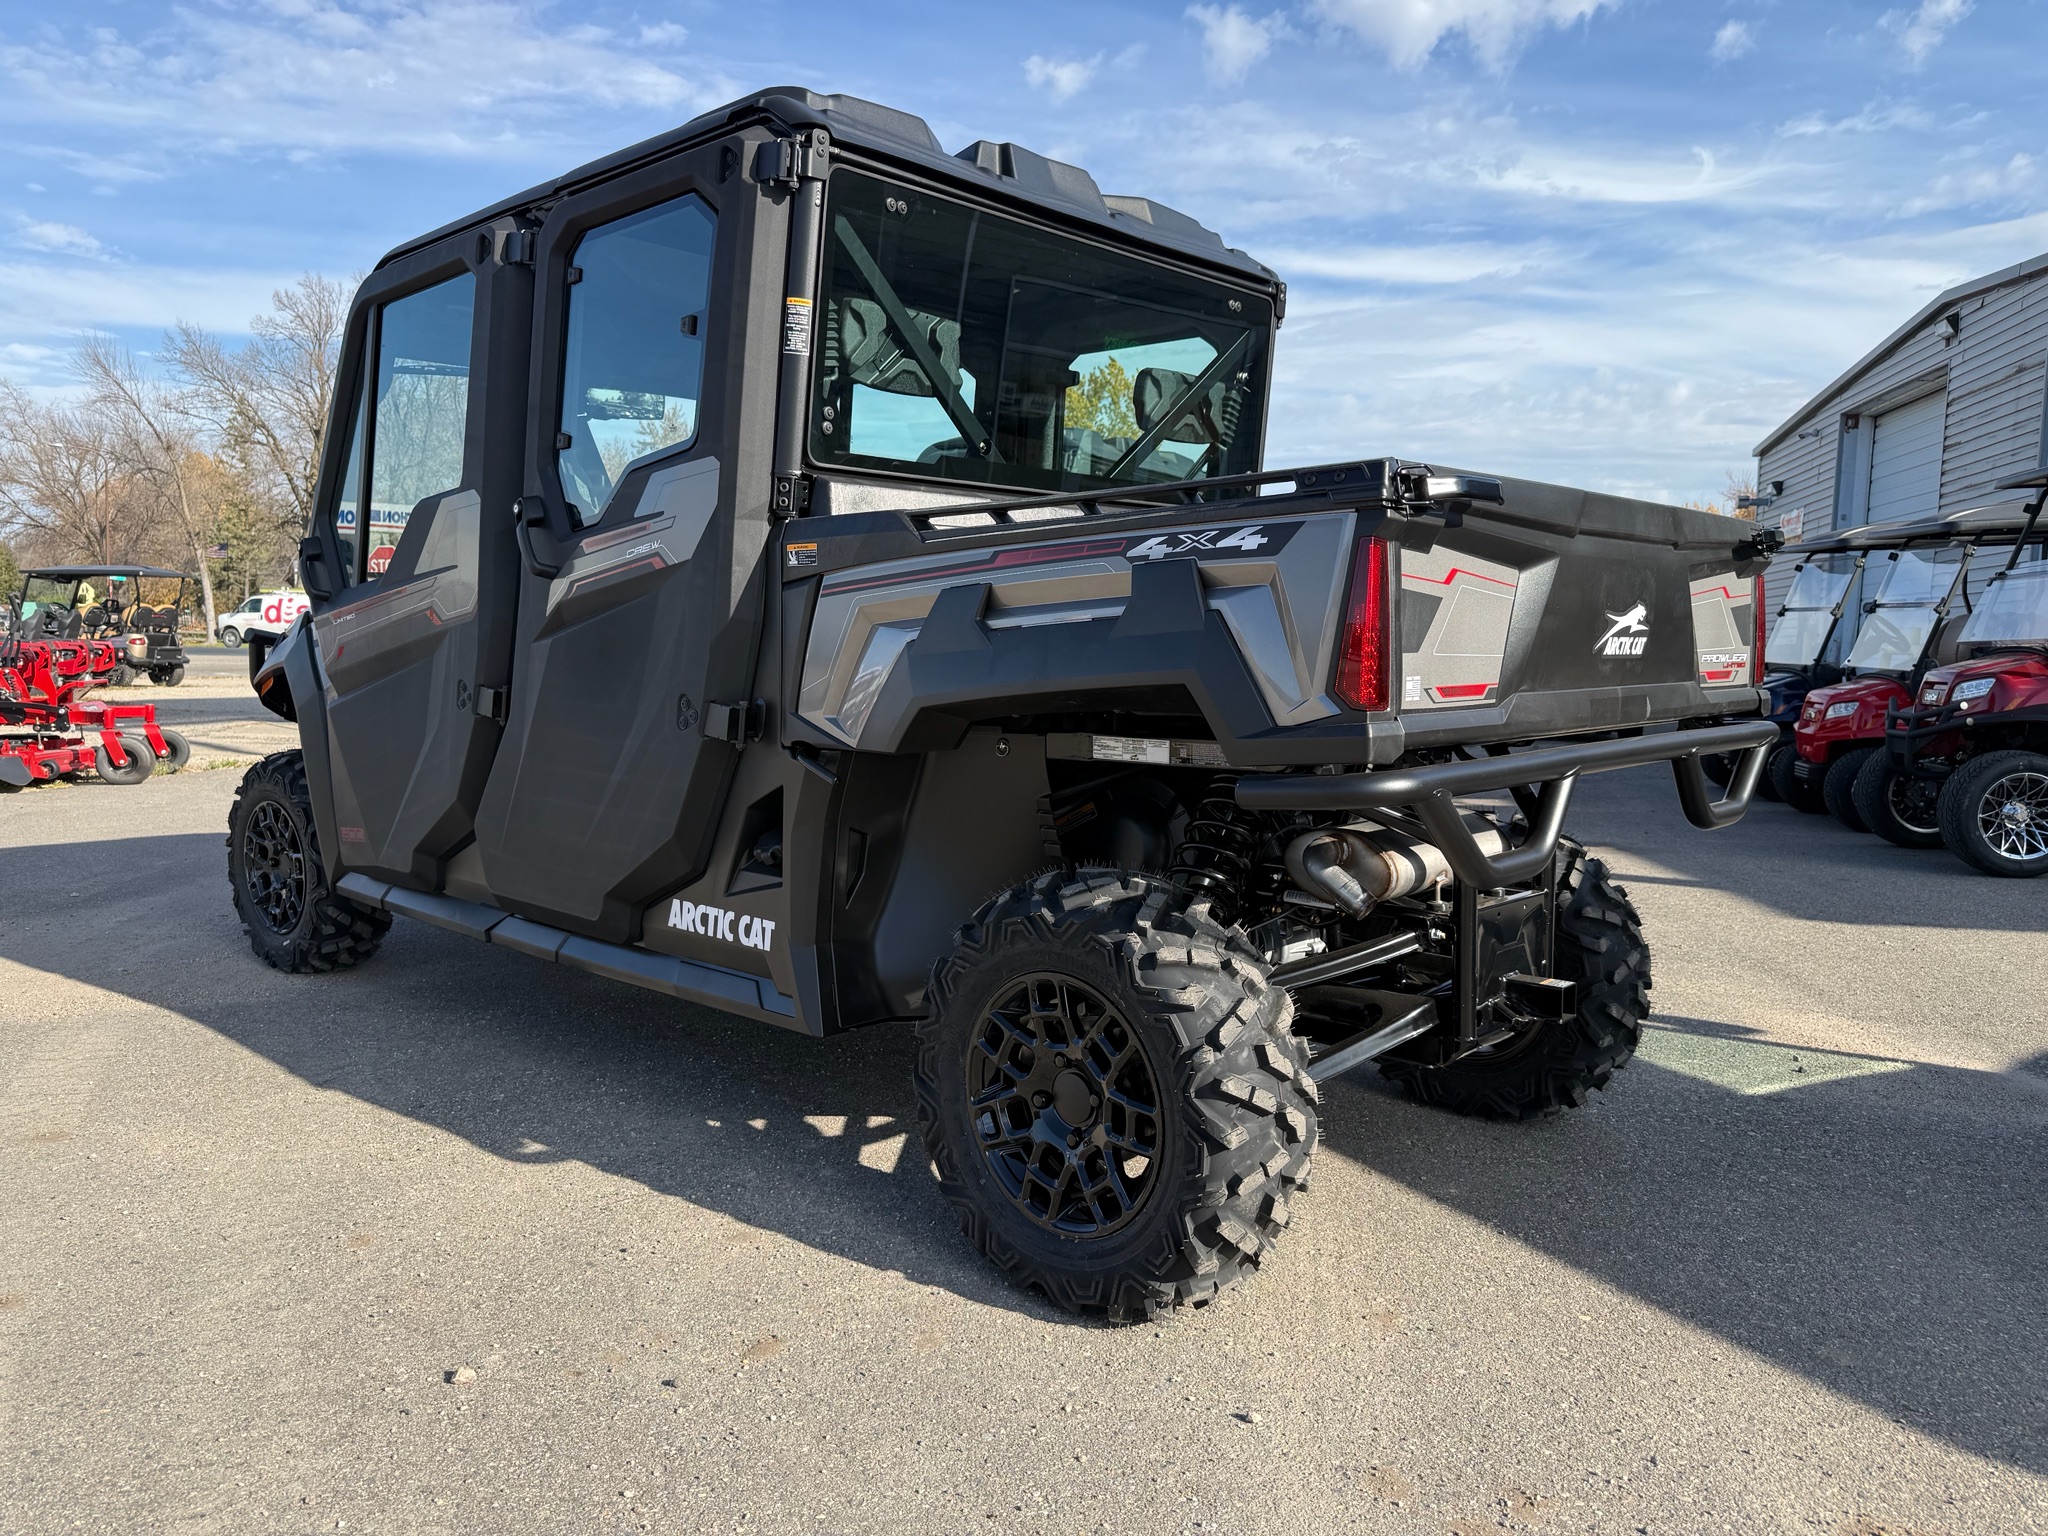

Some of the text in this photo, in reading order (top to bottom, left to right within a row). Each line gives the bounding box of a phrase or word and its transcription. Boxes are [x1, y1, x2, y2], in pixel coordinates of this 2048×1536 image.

[626, 539, 661, 558] CREW
[370, 559, 392, 573] ST
[1602, 636, 1648, 655] ARCTIC CAT
[1701, 653, 1747, 663] PROWLER
[667, 898, 776, 952] ARCTIC CAT
